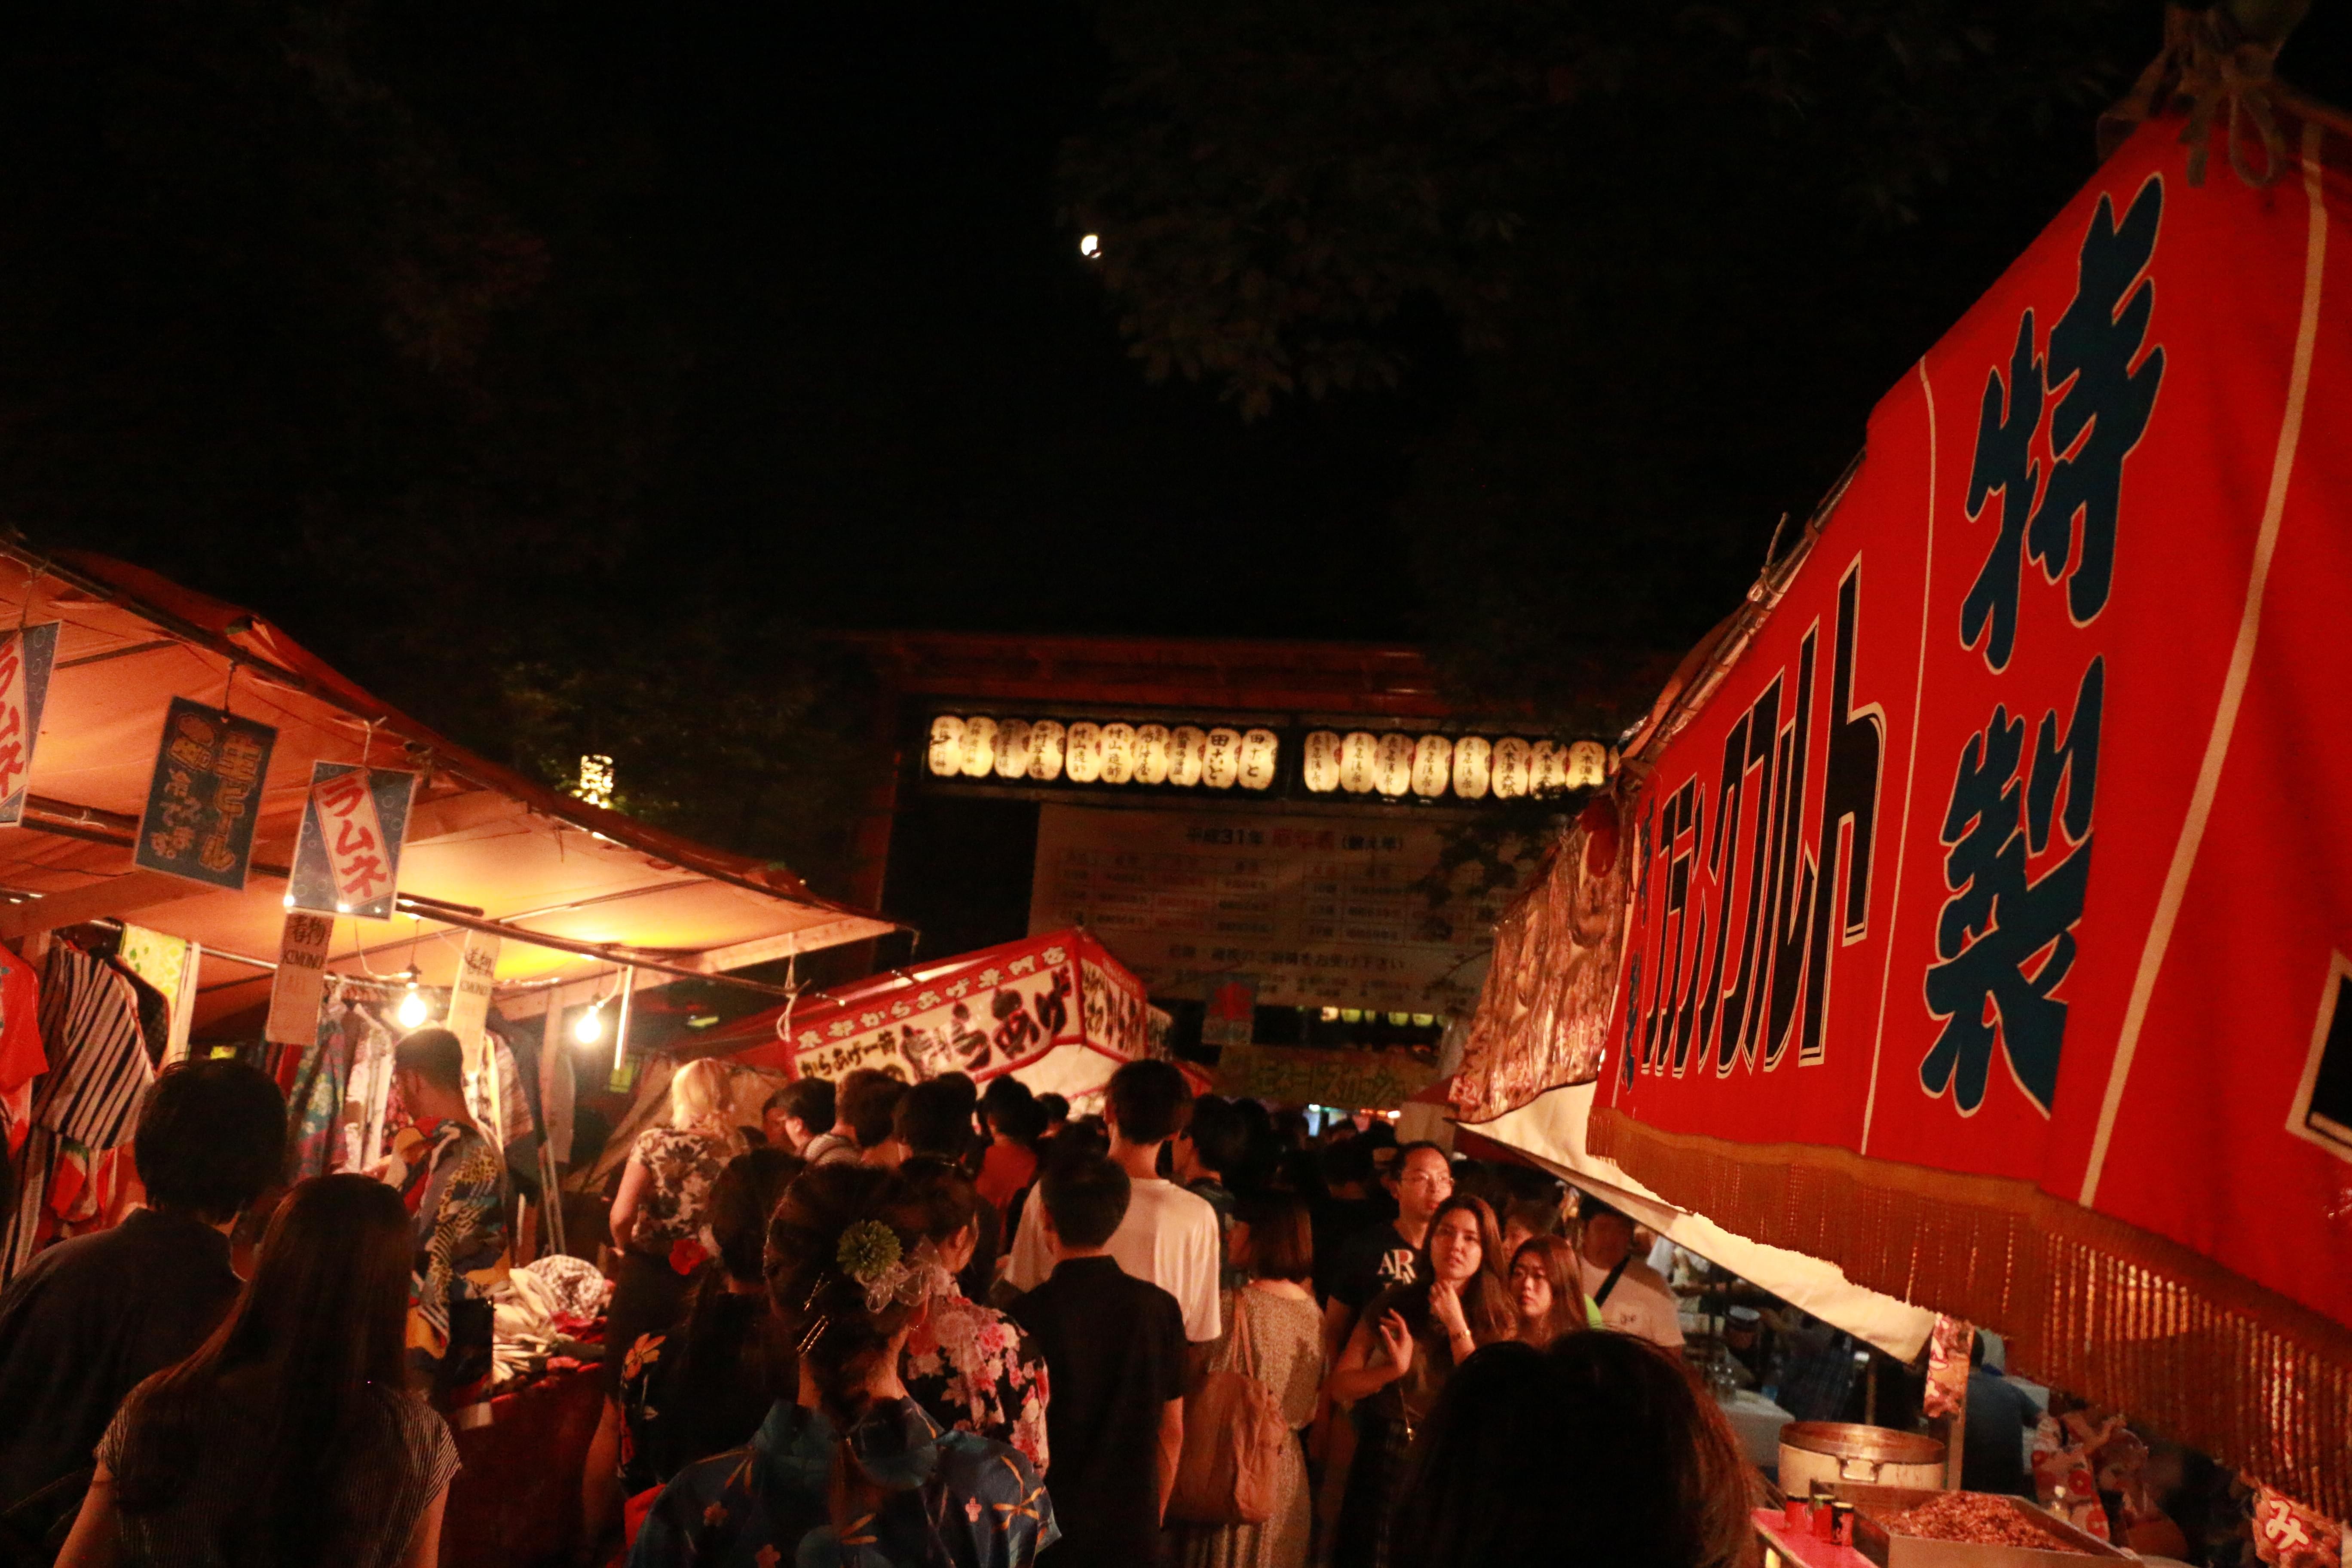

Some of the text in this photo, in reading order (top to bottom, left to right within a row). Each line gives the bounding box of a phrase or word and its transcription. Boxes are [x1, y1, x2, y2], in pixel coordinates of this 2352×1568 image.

[322, 778, 387, 898] ラムネ
[1920, 172, 2165, 1120] 特製
